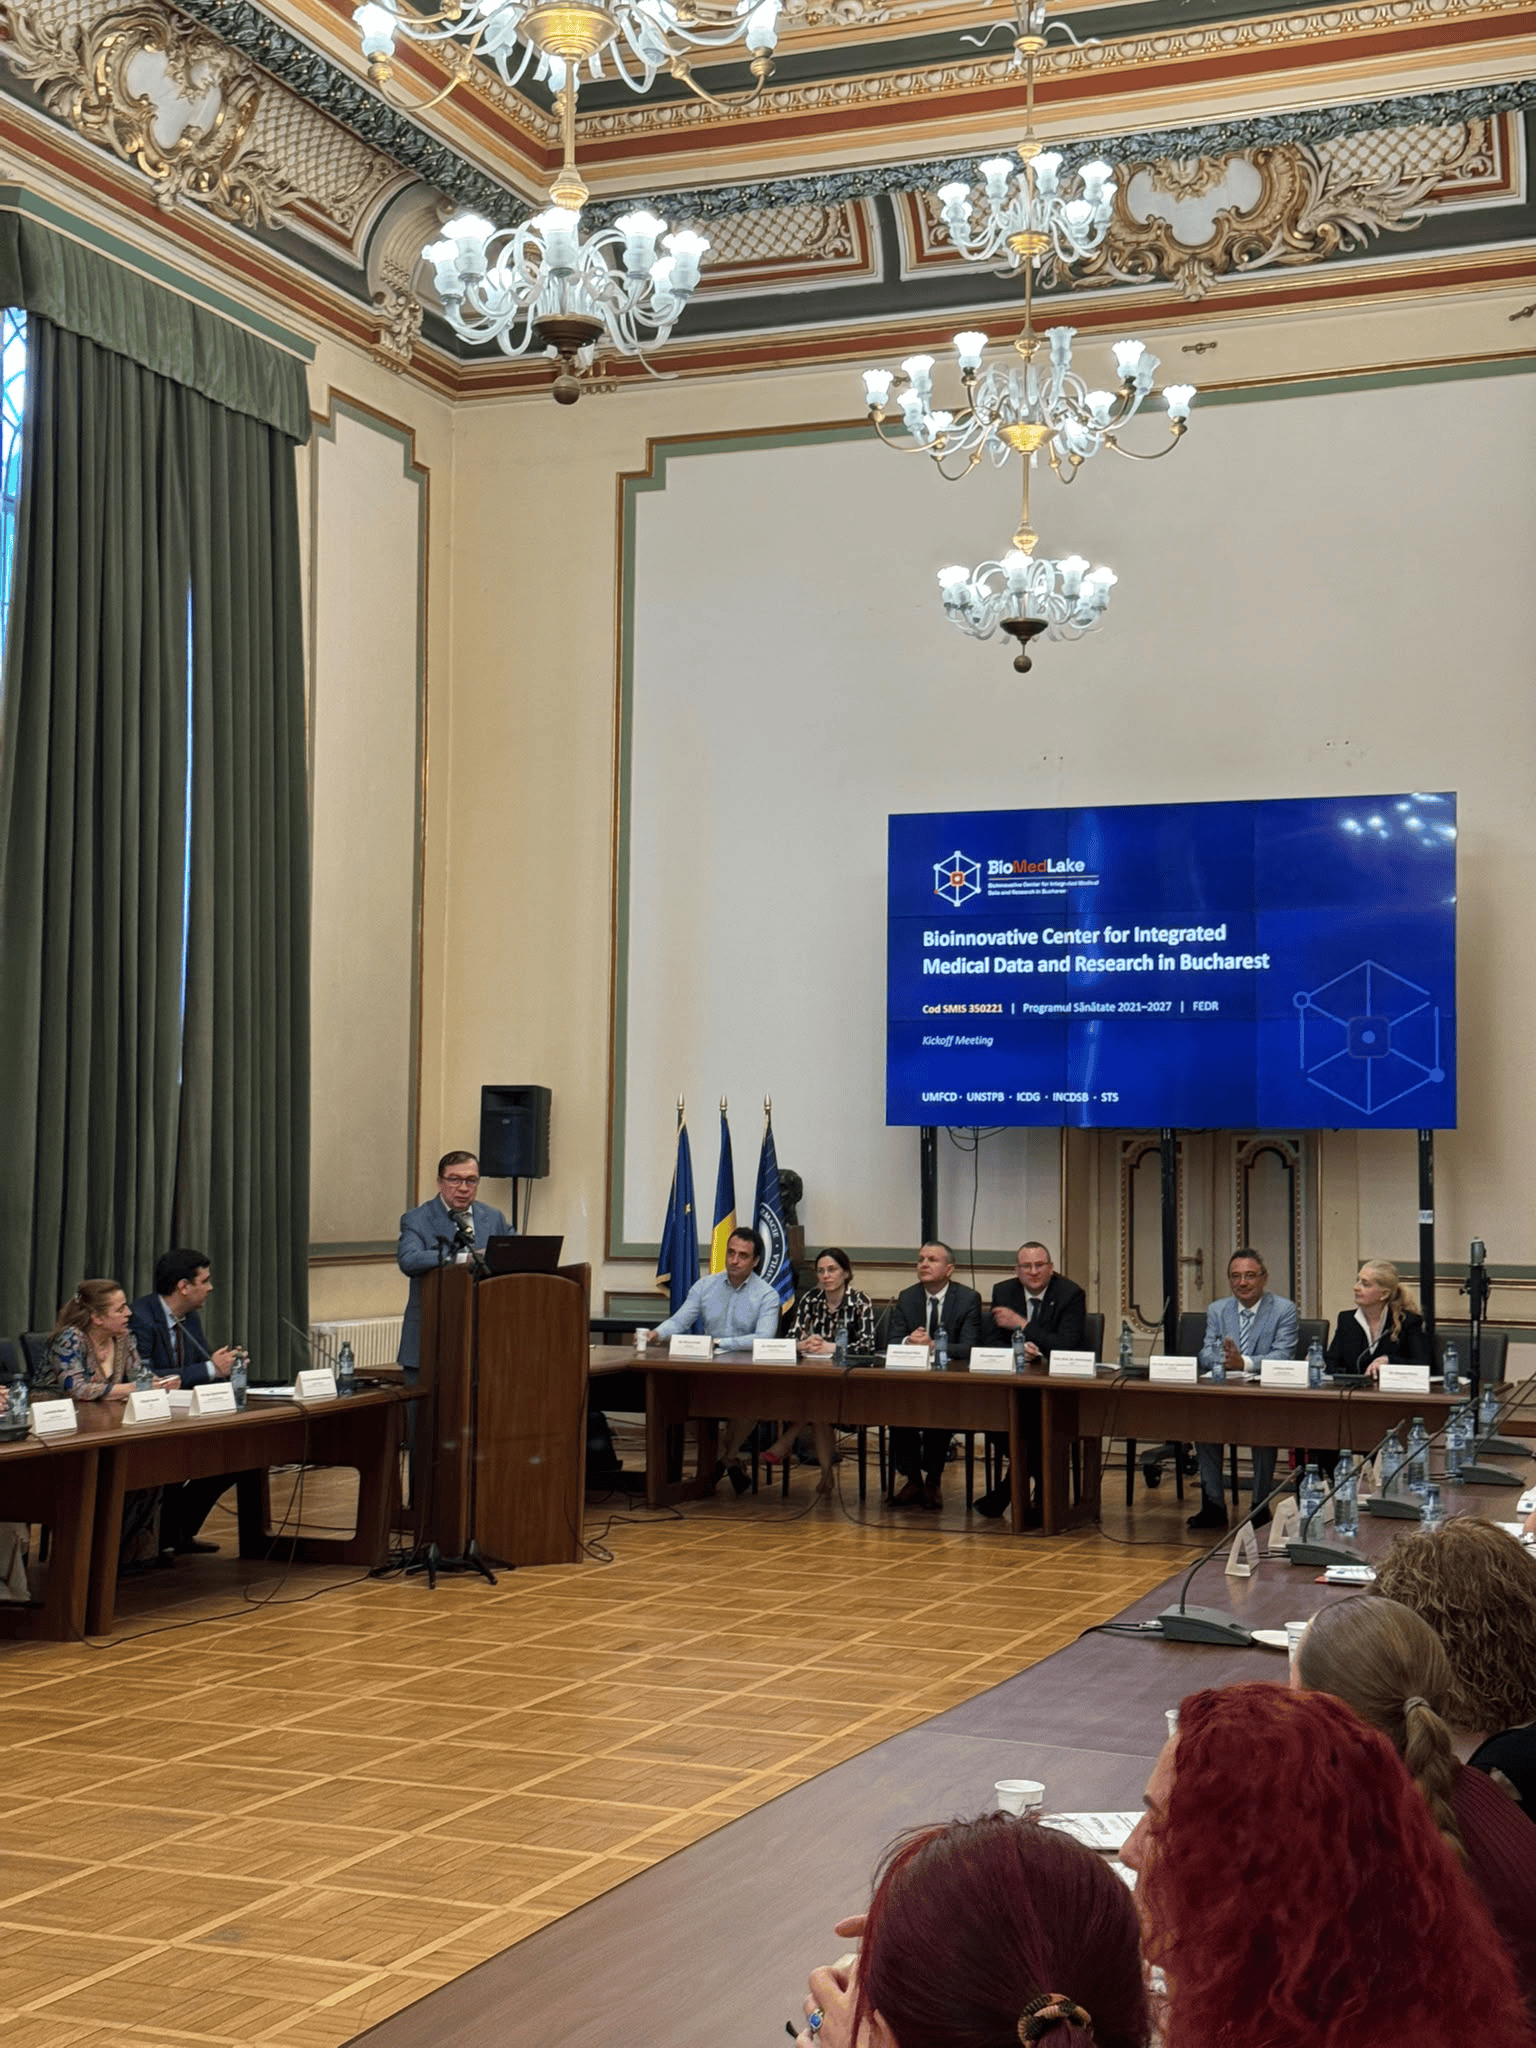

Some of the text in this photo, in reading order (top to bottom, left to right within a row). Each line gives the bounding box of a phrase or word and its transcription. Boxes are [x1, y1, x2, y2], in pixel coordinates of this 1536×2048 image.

[987, 858, 1086, 875] BioMedLake
[923, 923, 1227, 947] Bioinnovative Center for Integrated
[923, 952, 1270, 975] Medical Data and Research in Bucharest
[922, 1004, 941, 1014] Cod
[942, 1004, 967, 1014] SMIS
[968, 1003, 1003, 1014] 350221
[1022, 1002, 1072, 1015] Programul
[1192, 1001, 1219, 1011] FEDR
[922, 1035, 994, 1047] Kickoff Meeting
[922, 1092, 1119, 1102] UMFCD UNSTPB ICDG INCDSB STS
